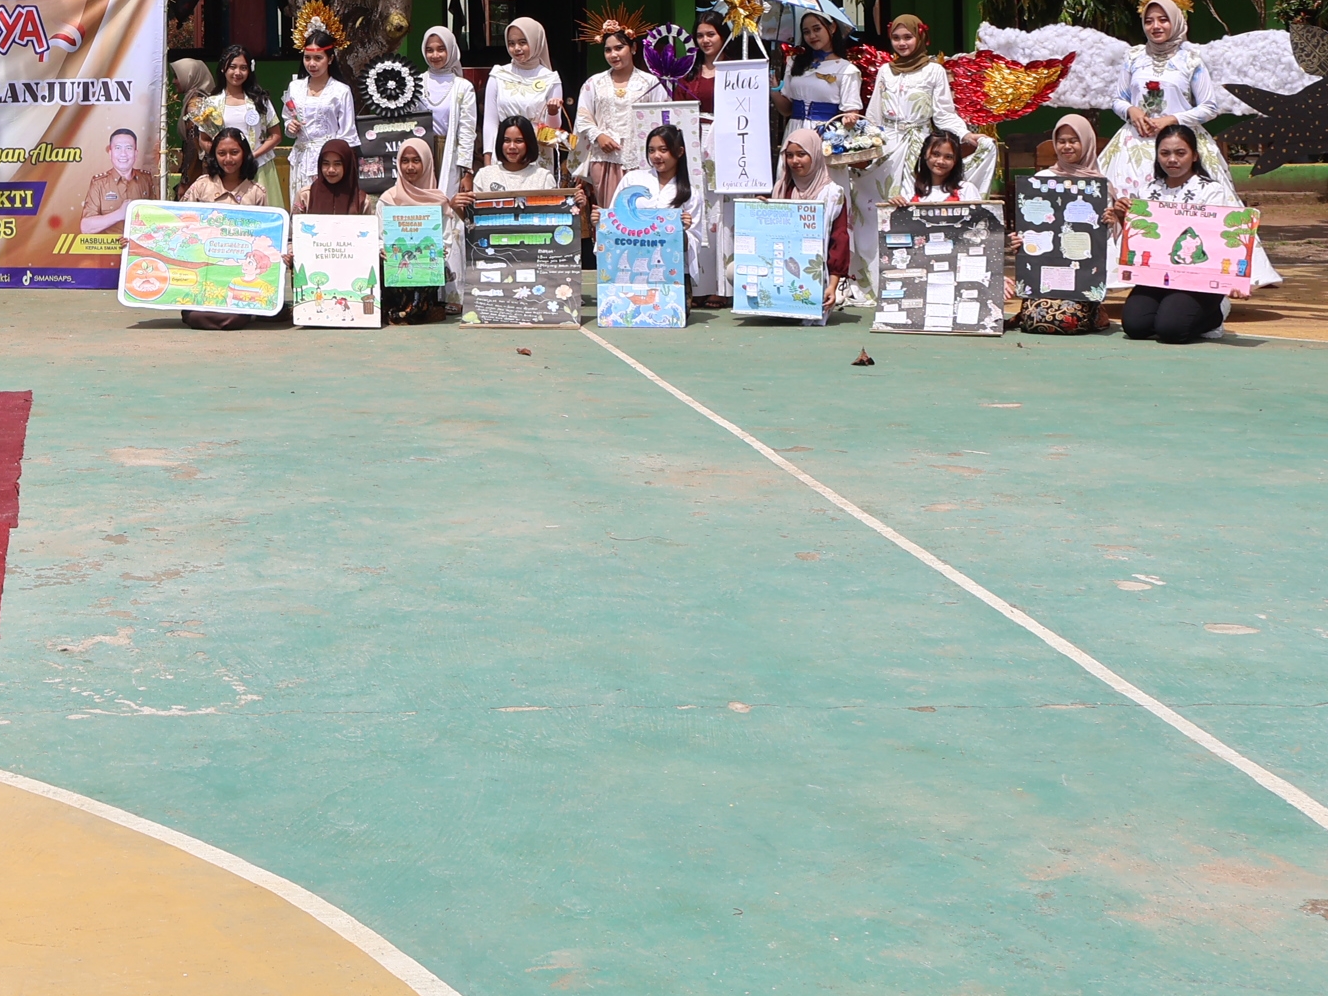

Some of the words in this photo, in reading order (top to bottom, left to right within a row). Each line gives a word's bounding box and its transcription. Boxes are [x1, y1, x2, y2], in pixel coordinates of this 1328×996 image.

[724, 70, 760, 91] kelas
[735, 96, 751, 113] XI
[30, 142, 82, 165] Alam
[797, 205, 816, 213] POU
[1158, 201, 1178, 209] DAUR
[1180, 203, 1206, 212] ULANG
[749, 209, 794, 218] ECOPRINT
[1174, 209, 1198, 217] UNTUK
[1200, 211, 1217, 219] BUMI
[608, 211, 659, 238] KELOMPOK
[757, 217, 792, 226] TEKNIK
[614, 238, 667, 247] ECOPRINT
